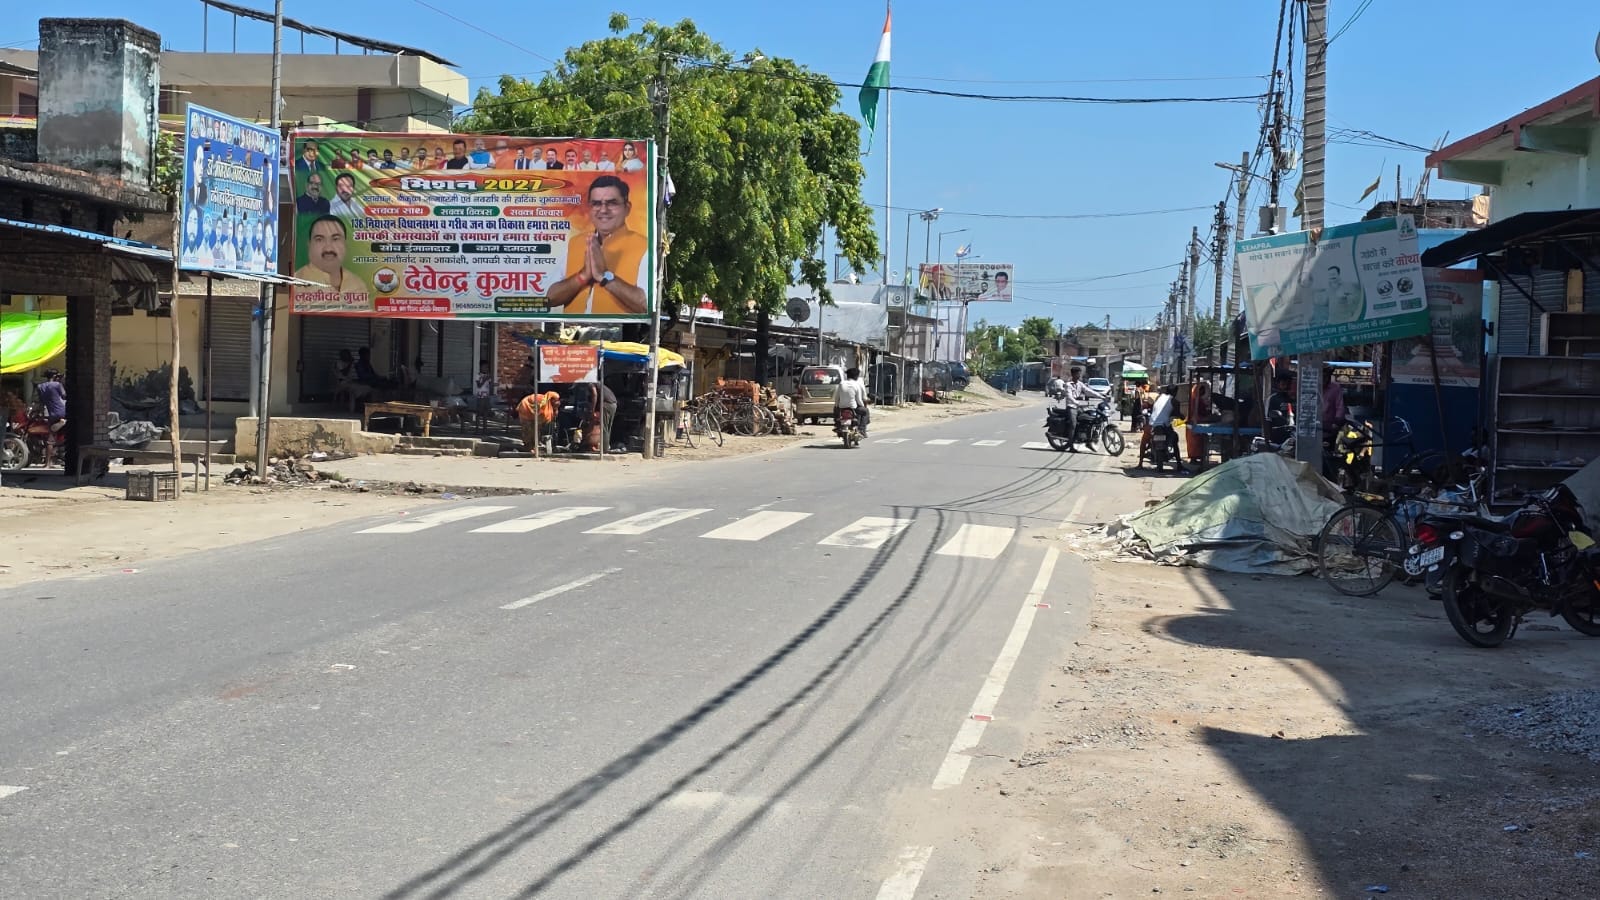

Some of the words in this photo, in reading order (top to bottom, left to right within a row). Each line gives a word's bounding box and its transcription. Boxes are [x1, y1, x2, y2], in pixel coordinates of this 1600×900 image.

[400, 177, 477, 190] मिशन
[484, 179, 543, 191] 2027
[501, 194, 512, 203] की
[515, 195, 536, 204] हार्दिक
[370, 207, 399, 215] सबका
[402, 206, 423, 215] साथ
[466, 207, 493, 216] विकास
[510, 208, 533, 216] सबका
[536, 207, 563, 216] विश्वास
[365, 217, 396, 229] निघासन
[399, 217, 438, 229] विधानसभा
[440, 220, 447, 229] व
[448, 217, 467, 229] गरीब
[469, 219, 484, 230] जन
[486, 219, 497, 230] का
[498, 217, 525, 230] विकास
[527, 219, 549, 230] हमारा
[550, 219, 570, 230] लक्ष्य
[354, 231, 389, 241] आपकी
[393, 231, 439, 241] समस्याओं
[443, 232, 457, 241] का
[461, 232, 499, 241] समाधान
[502, 232, 530, 241] हमारा
[533, 231, 566, 241] संकल्प
[379, 243, 401, 252] सोच
[475, 244, 500, 252] काम
[503, 244, 538, 252] दमदार
[1242, 242, 1271, 252] SEMPRA
[353, 255, 378, 264] आपके
[381, 254, 417, 264] आशीर्वाद
[419, 256, 431, 264] का
[472, 255, 500, 264] आपकी
[504, 255, 521, 264] सेवा
[523, 255, 531, 264] में
[1395, 253, 1420, 266] मोथा
[404, 265, 470, 293] देवेन्द्र
[476, 271, 547, 297] कुमार
[344, 292, 369, 304] गुप्ता
